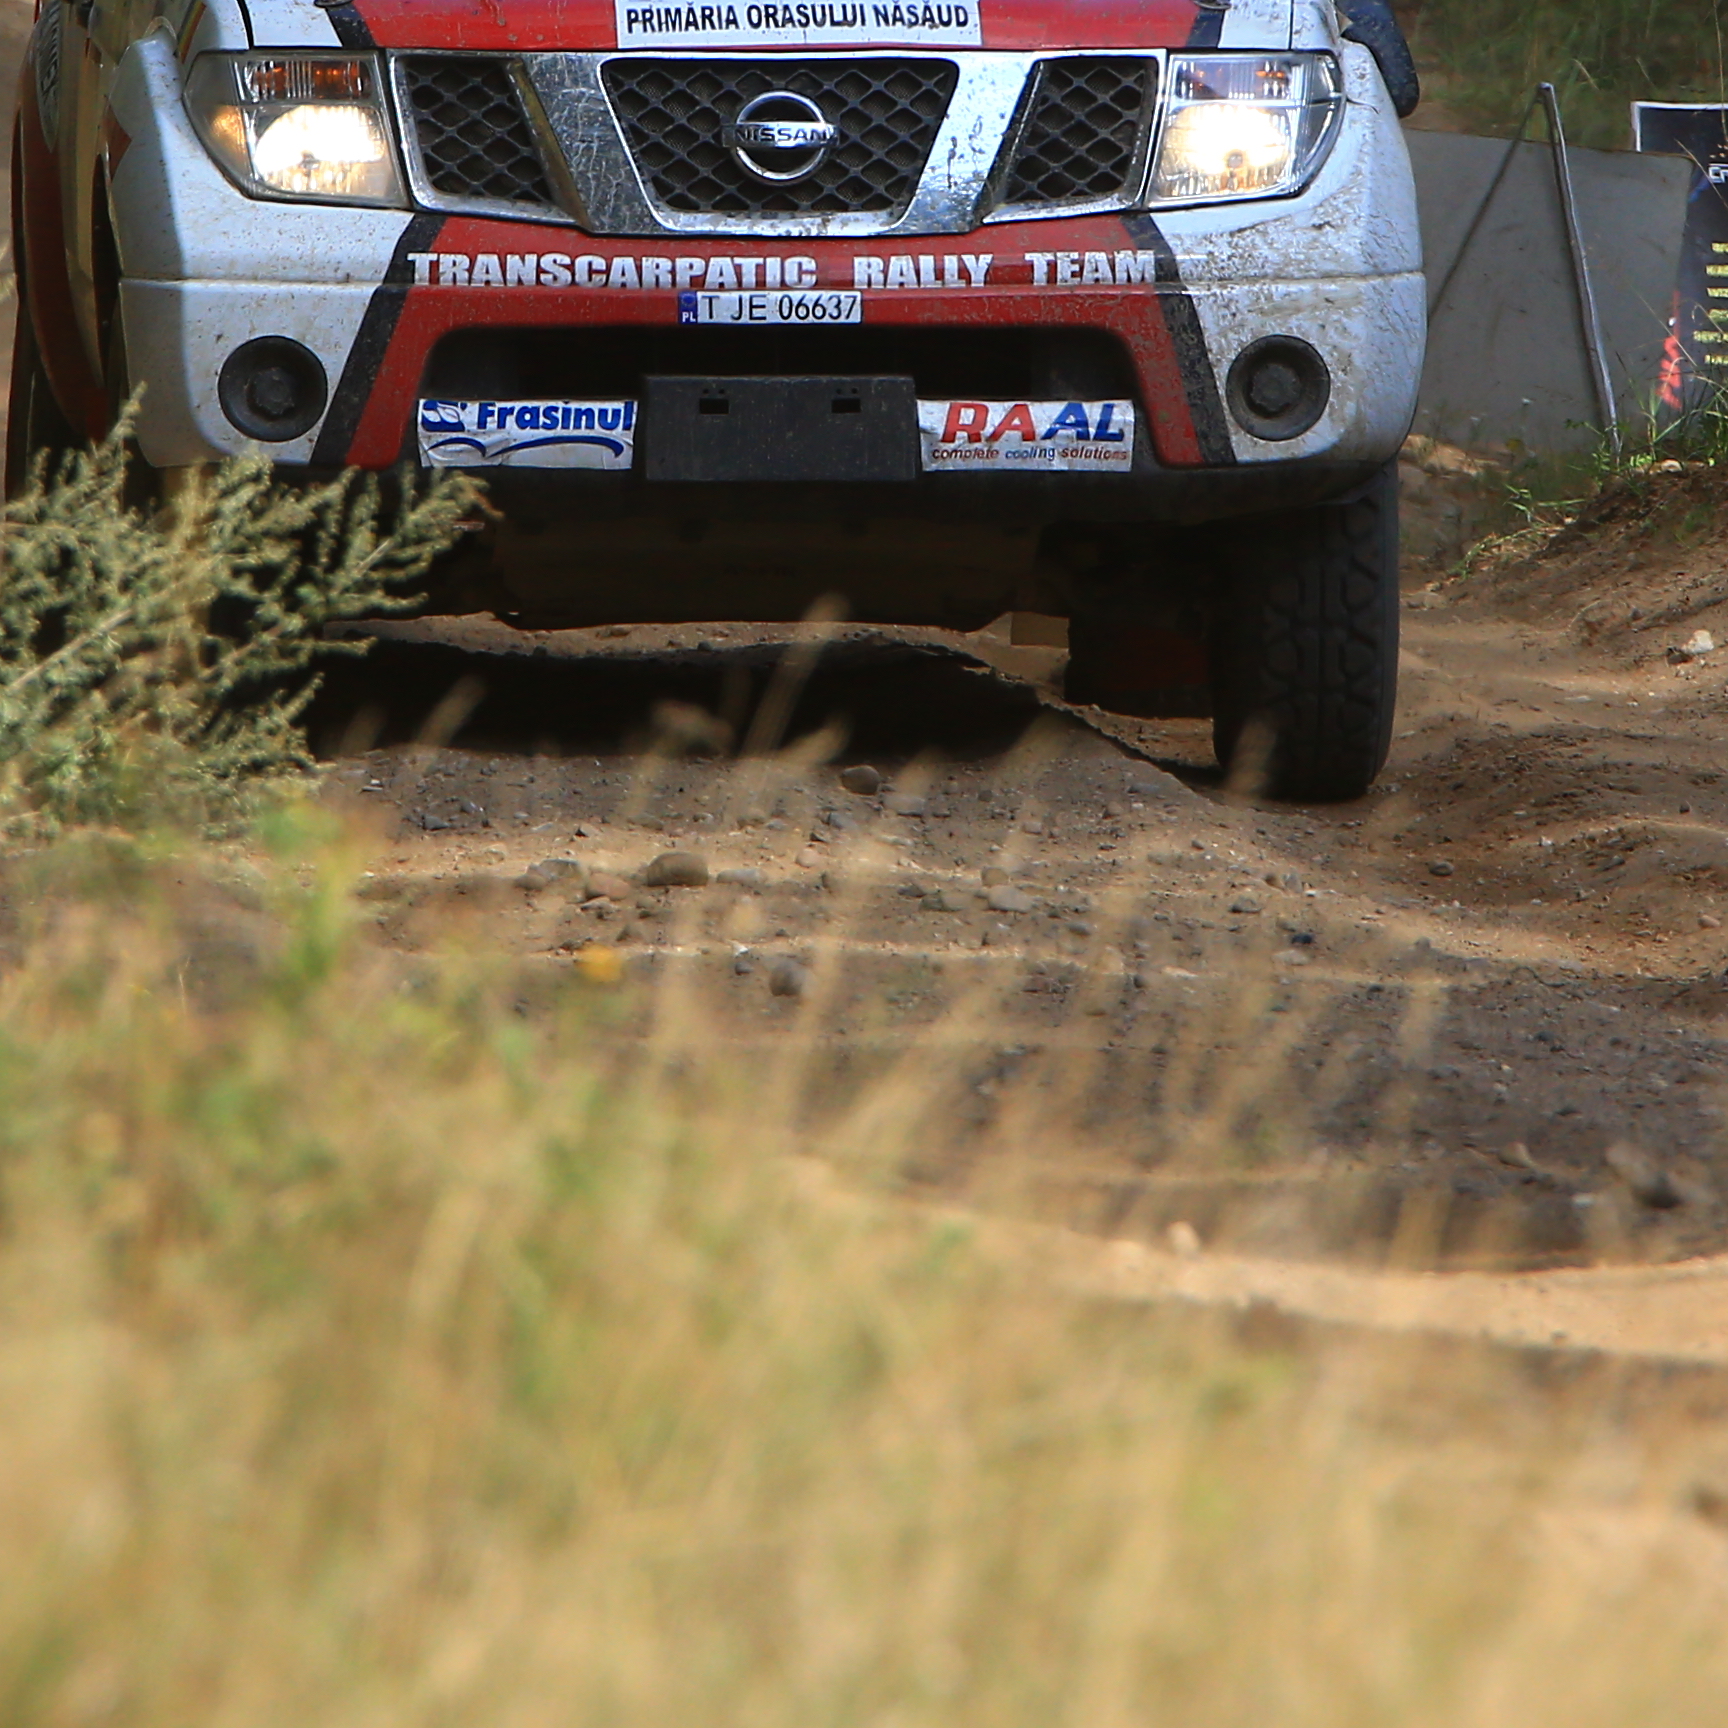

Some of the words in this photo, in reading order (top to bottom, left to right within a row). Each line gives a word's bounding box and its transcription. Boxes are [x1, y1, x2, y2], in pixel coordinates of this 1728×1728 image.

[626, 1, 739, 34] PRIMĂRIA
[872, 0, 969, 29] NĂSĂUD
[734, 127, 828, 143] NISSAN
[407, 252, 818, 290] TRANSCARPATIC
[854, 253, 993, 289] RALLY
[1024, 249, 1156, 287] TEAM
[682, 311, 696, 322] PL
[778, 294, 858, 321] 06637
[476, 400, 635, 431] Frasinul
[940, 402, 1125, 443] RAAL
[932, 446, 1000, 460] complete
[1005, 446, 1056, 461] cooling
[1061, 446, 1128, 460] solutions
